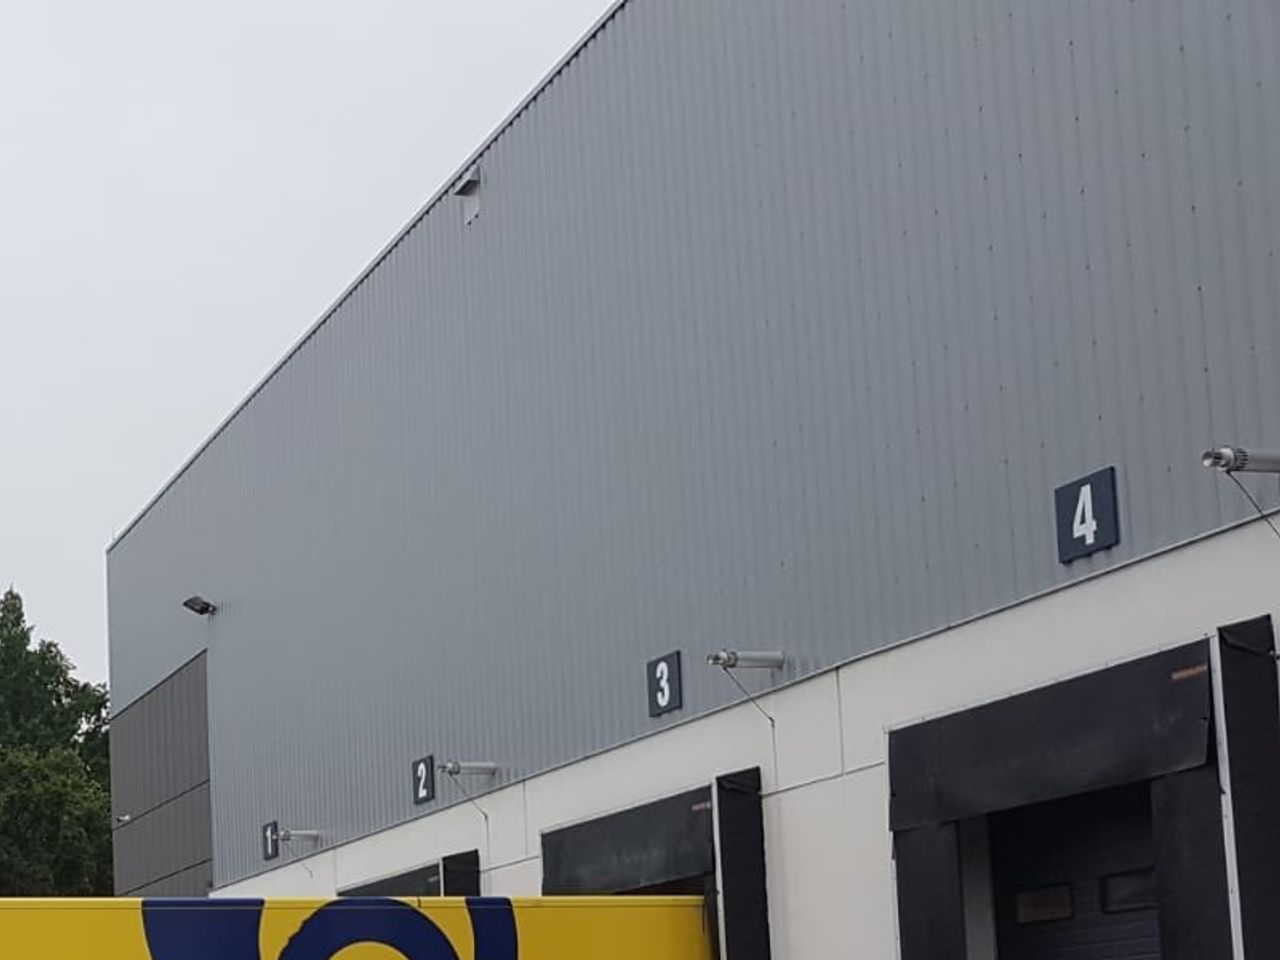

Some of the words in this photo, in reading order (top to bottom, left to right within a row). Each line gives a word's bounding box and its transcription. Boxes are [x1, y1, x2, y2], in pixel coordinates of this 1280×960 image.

[1073, 484, 1097, 545] 4
[656, 661, 670, 707] 3
[417, 762, 427, 798] 2
